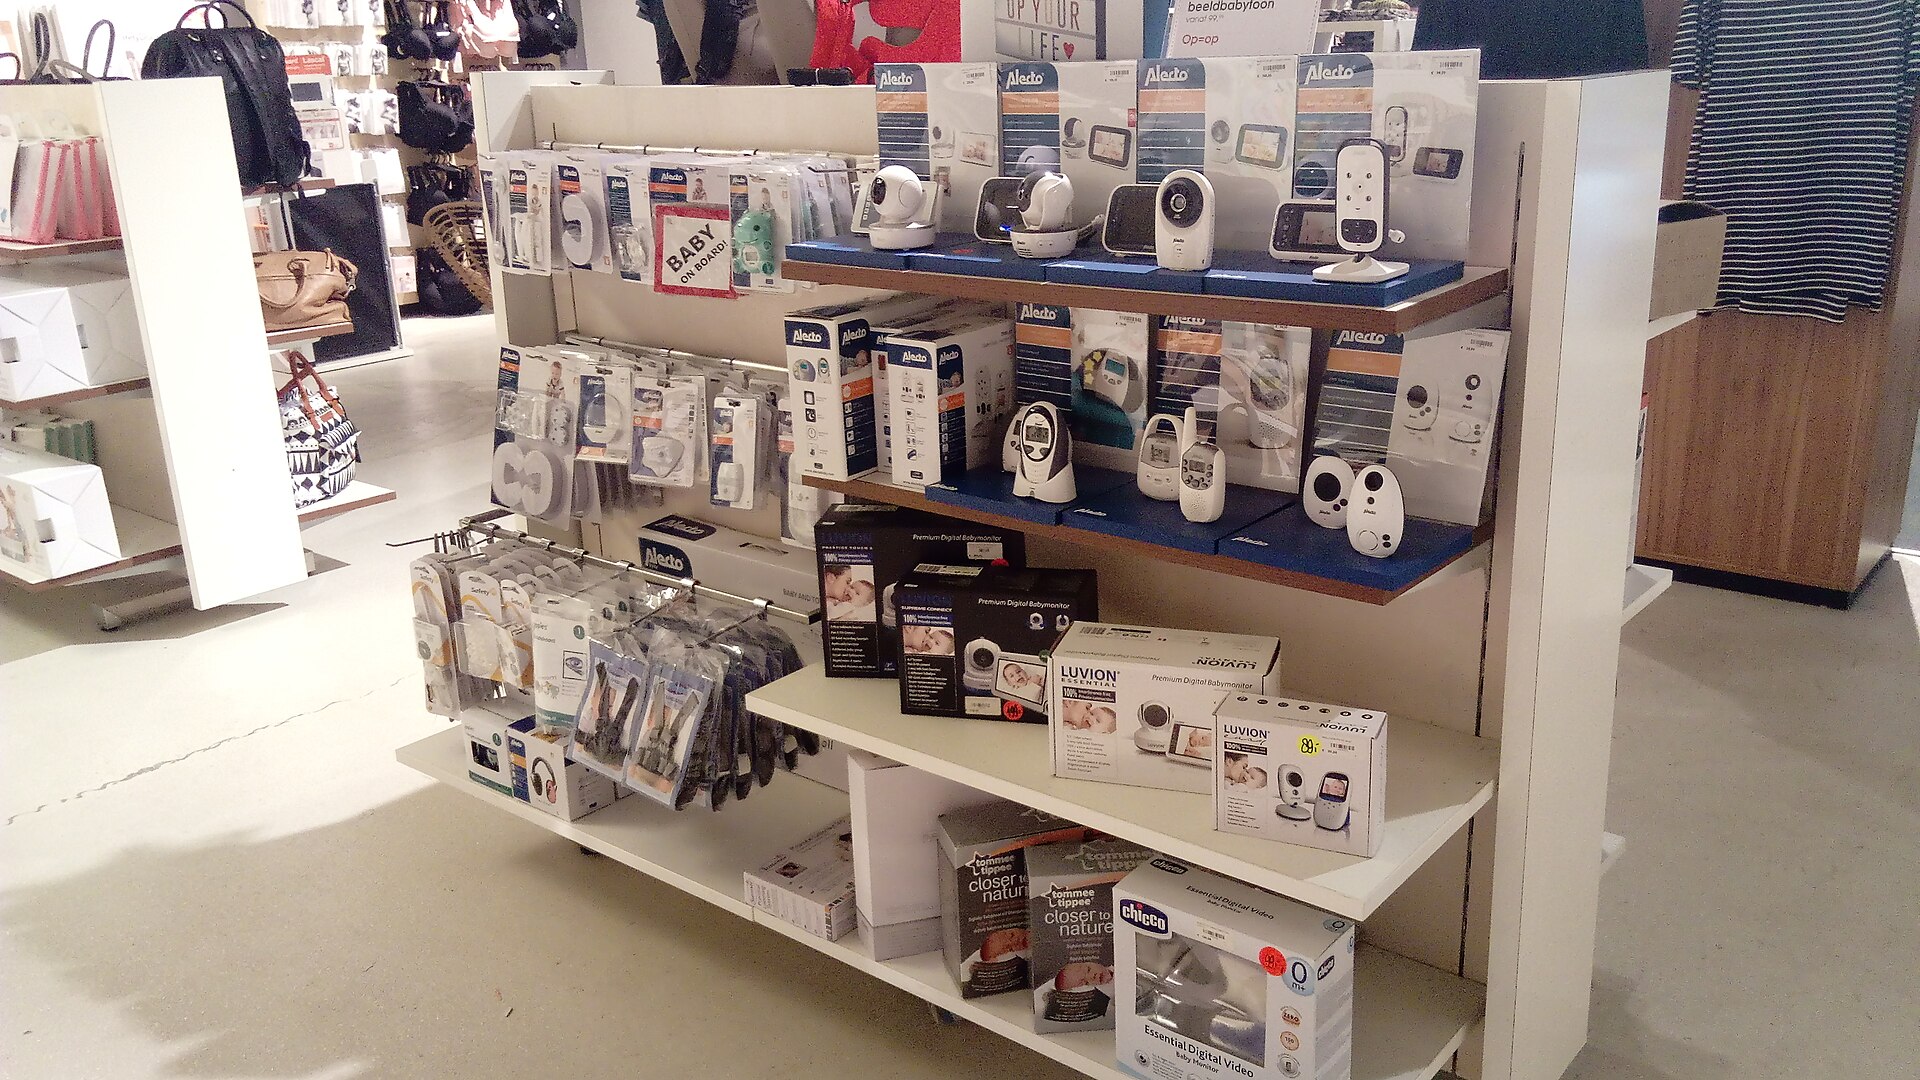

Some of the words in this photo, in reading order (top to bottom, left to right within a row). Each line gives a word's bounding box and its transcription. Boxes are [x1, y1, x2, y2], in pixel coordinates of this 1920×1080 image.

[1007, 0, 1025, 20] UP
[1033, 0, 1080, 30] YOUR
[1182, 34, 1219, 46] Op=op
[880, 70, 913, 90] Alecto
[1006, 71, 1044, 90] Alecto
[1144, 64, 1189, 87] Alecto
[1304, 62, 1354, 85] Alecto
[661, 171, 683, 182] Alecto
[666, 223, 715, 272] BABY
[680, 269, 695, 284] ON
[694, 240, 728, 271] BOARD!
[1020, 303, 1056, 320] Alecto
[793, 328, 822, 344] Alecto
[842, 328, 867, 346] Alecto
[1336, 330, 1386, 345] Alecto
[902, 351, 927, 363] Alecto
[939, 350, 959, 366] Alecto
[912, 533, 940, 541] Premium
[941, 534, 962, 542] Digital
[962, 535, 1002, 543] Babymonitor
[645, 547, 684, 572] Alecto
[978, 597, 1007, 606] Premium
[1007, 599, 1029, 608] Digital
[1028, 600, 1070, 610] Babymonitor
[1197, 658, 1257, 670] LUVION
[1061, 666, 1117, 682] LUVION
[1151, 674, 1183, 684] Premium
[1183, 676, 1207, 687] Digital
[1207, 679, 1253, 690] Babymonitor
[1061, 678, 1117, 687] ESSENTIAL
[1224, 724, 1268, 739] LUVION
[1319, 723, 1366, 733] LUVION
[976, 854, 1015, 867] tommee
[1154, 860, 1185, 874] chicco
[980, 863, 1012, 875] tippee
[969, 874, 1016, 892] closer
[983, 884, 1029, 903] natur
[1051, 888, 1095, 899] tommee
[1057, 897, 1092, 908] tippee
[1186, 885, 1221, 901] Essential
[1222, 897, 1250, 911] Digital
[1251, 907, 1274, 920] Video
[1045, 909, 1097, 925] closer
[1099, 911, 1111, 921] to
[1122, 903, 1166, 930] chicco
[1059, 921, 1114, 937] nature
[1291, 961, 1308, 984] 0
[1291, 982, 1306, 992] m+
[1144, 1024, 1187, 1051] Essential
[1188, 1044, 1222, 1066] Digital
[1224, 1058, 1254, 1078] Video
[1176, 1051, 1191, 1064] Baby
[1192, 1058, 1220, 1074] Monitor
